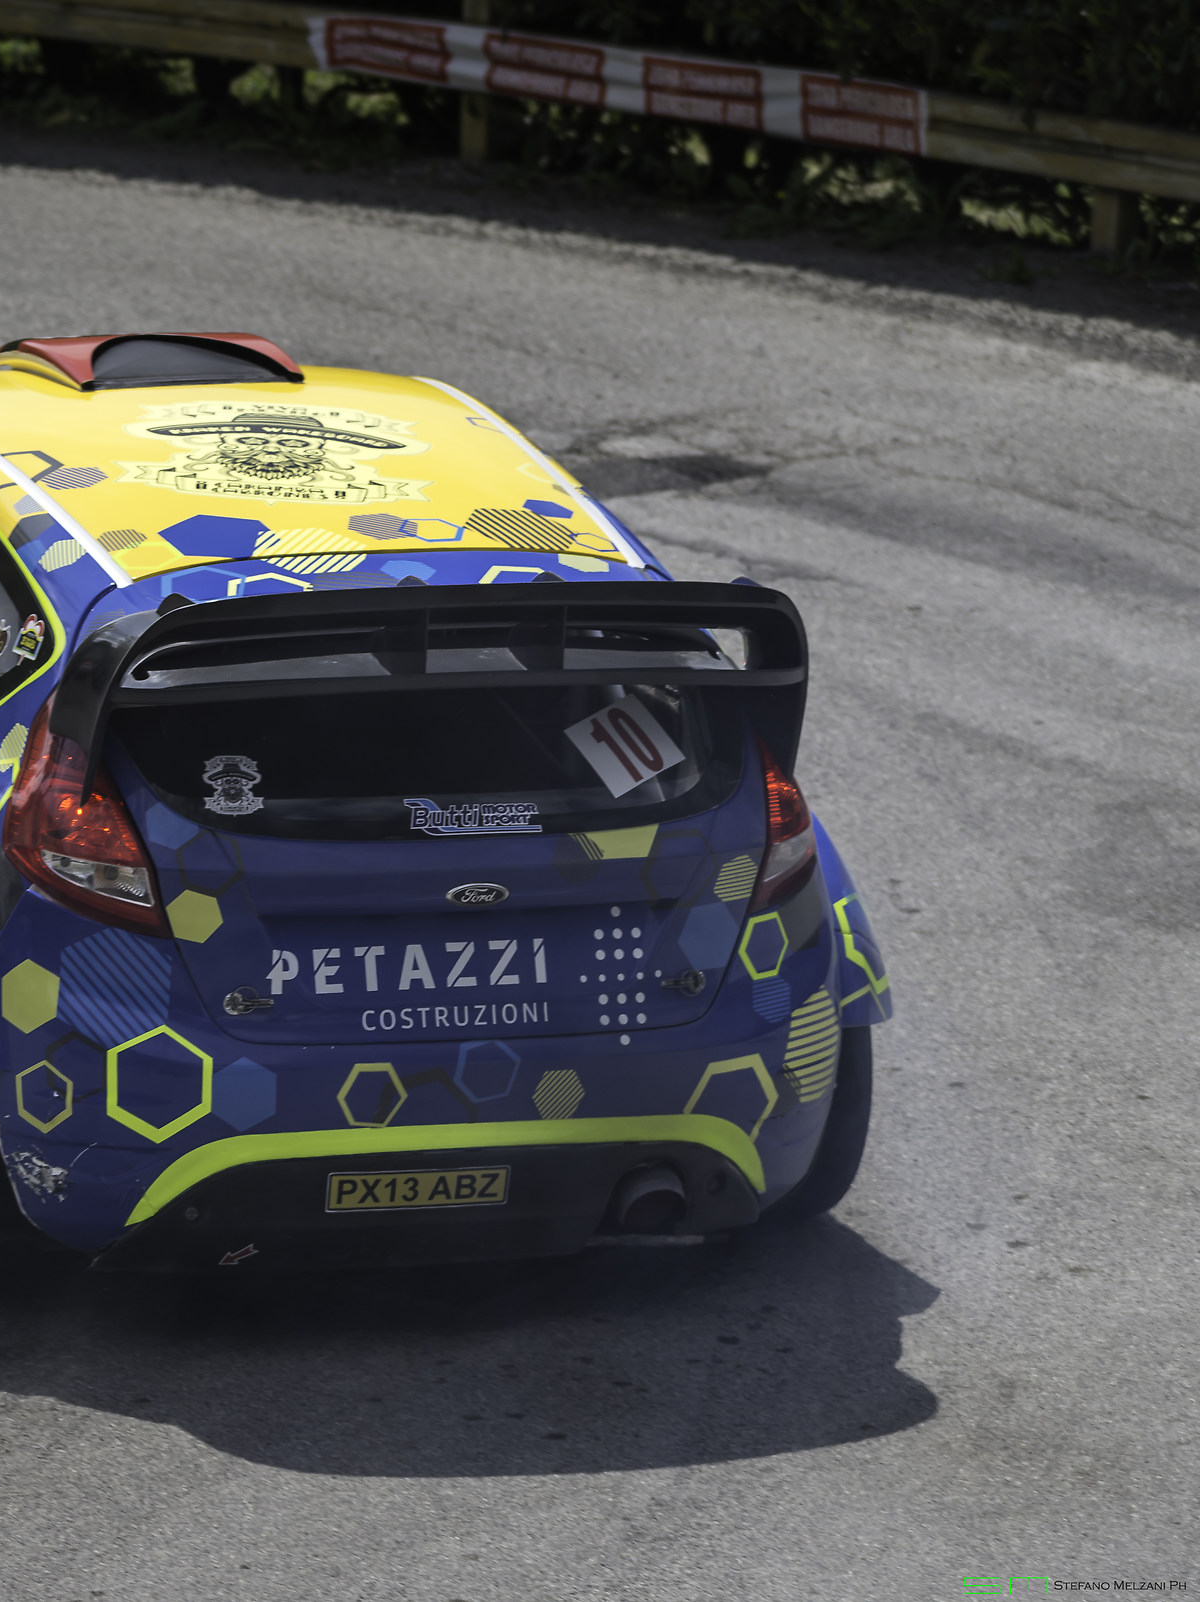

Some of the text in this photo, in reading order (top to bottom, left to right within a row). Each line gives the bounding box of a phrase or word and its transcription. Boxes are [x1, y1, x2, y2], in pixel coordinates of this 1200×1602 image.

[590, 706, 664, 782] 10
[410, 802, 539, 830] Butti MOTOR
[483, 813, 531, 826] SPORT
[461, 888, 497, 903] Ford
[265, 938, 548, 995] PETAZZI
[361, 1001, 549, 1031] COSTRUZIONI
[336, 1172, 500, 1204] PX13 ABZ
